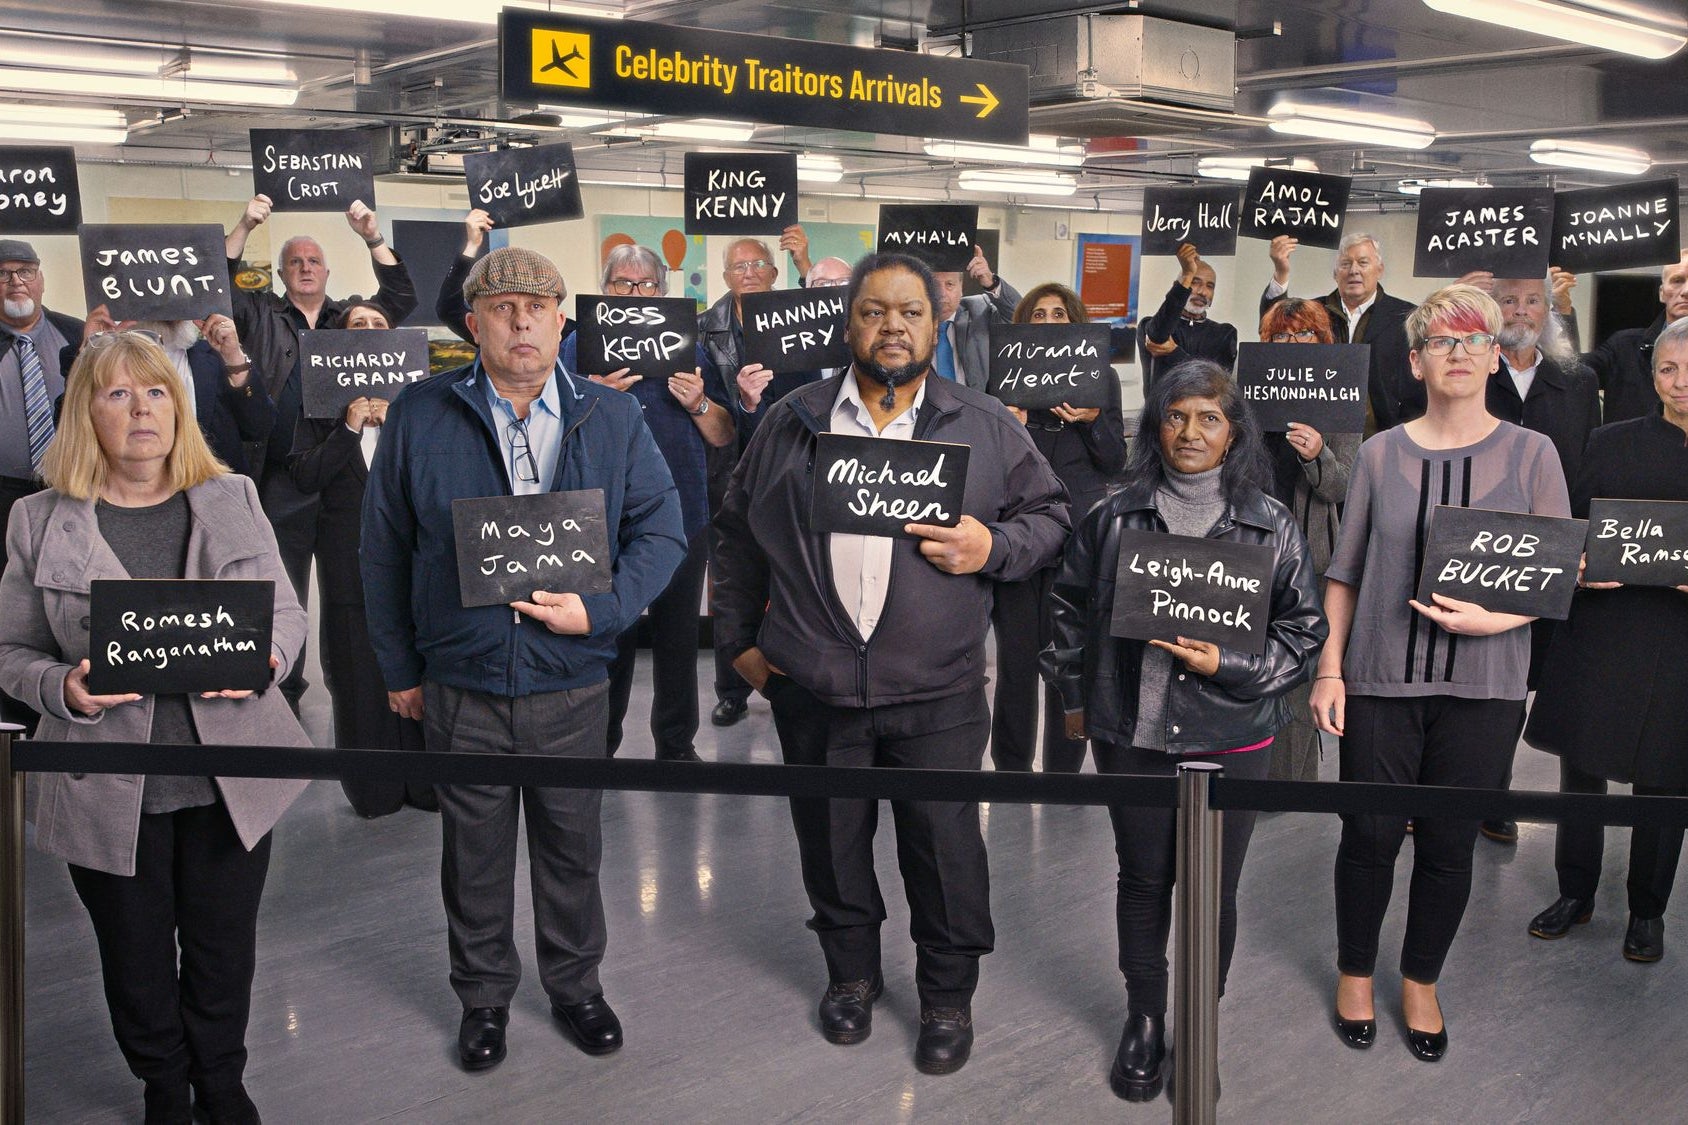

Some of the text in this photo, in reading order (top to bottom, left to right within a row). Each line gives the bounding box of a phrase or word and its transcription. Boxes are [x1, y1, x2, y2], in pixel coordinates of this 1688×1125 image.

[615, 44, 943, 108] Celebrity Traitors Arrivals
[478, 167, 570, 209] Joe Lycett
[708, 168, 766, 191] KING
[1259, 180, 1330, 206] AMOL
[695, 191, 786, 220] KENNY
[1254, 206, 1339, 228] RAJAN
[1445, 205, 1525, 227] JAMES
[1569, 197, 1668, 226] JOANNE
[1146, 202, 1232, 241] Jerry Hall
[1427, 226, 1539, 253] ACASTER
[595, 301, 666, 327] ROSS
[755, 296, 844, 333] HANNAH
[780, 324, 834, 355] FRY
[997, 338, 1099, 360] Miranda
[336, 368, 425, 388] GRANT
[998, 363, 1085, 391] Heart
[1266, 367, 1315, 383] JULIE
[1243, 384, 1360, 402] HESMONDHALGH
[827, 453, 948, 488] Michael
[847, 488, 950, 521] Sheen
[481, 518, 583, 547] Maya
[1596, 518, 1664, 540] Bella
[1469, 530, 1541, 558] ROB
[480, 549, 596, 576] Jama
[1128, 553, 1261, 594] Leigh-Anne
[1437, 558, 1564, 592] BUCKET
[121, 605, 235, 632] Romesh
[1150, 589, 1252, 632] Pinnock
[107, 636, 257, 669] Ranganathan
